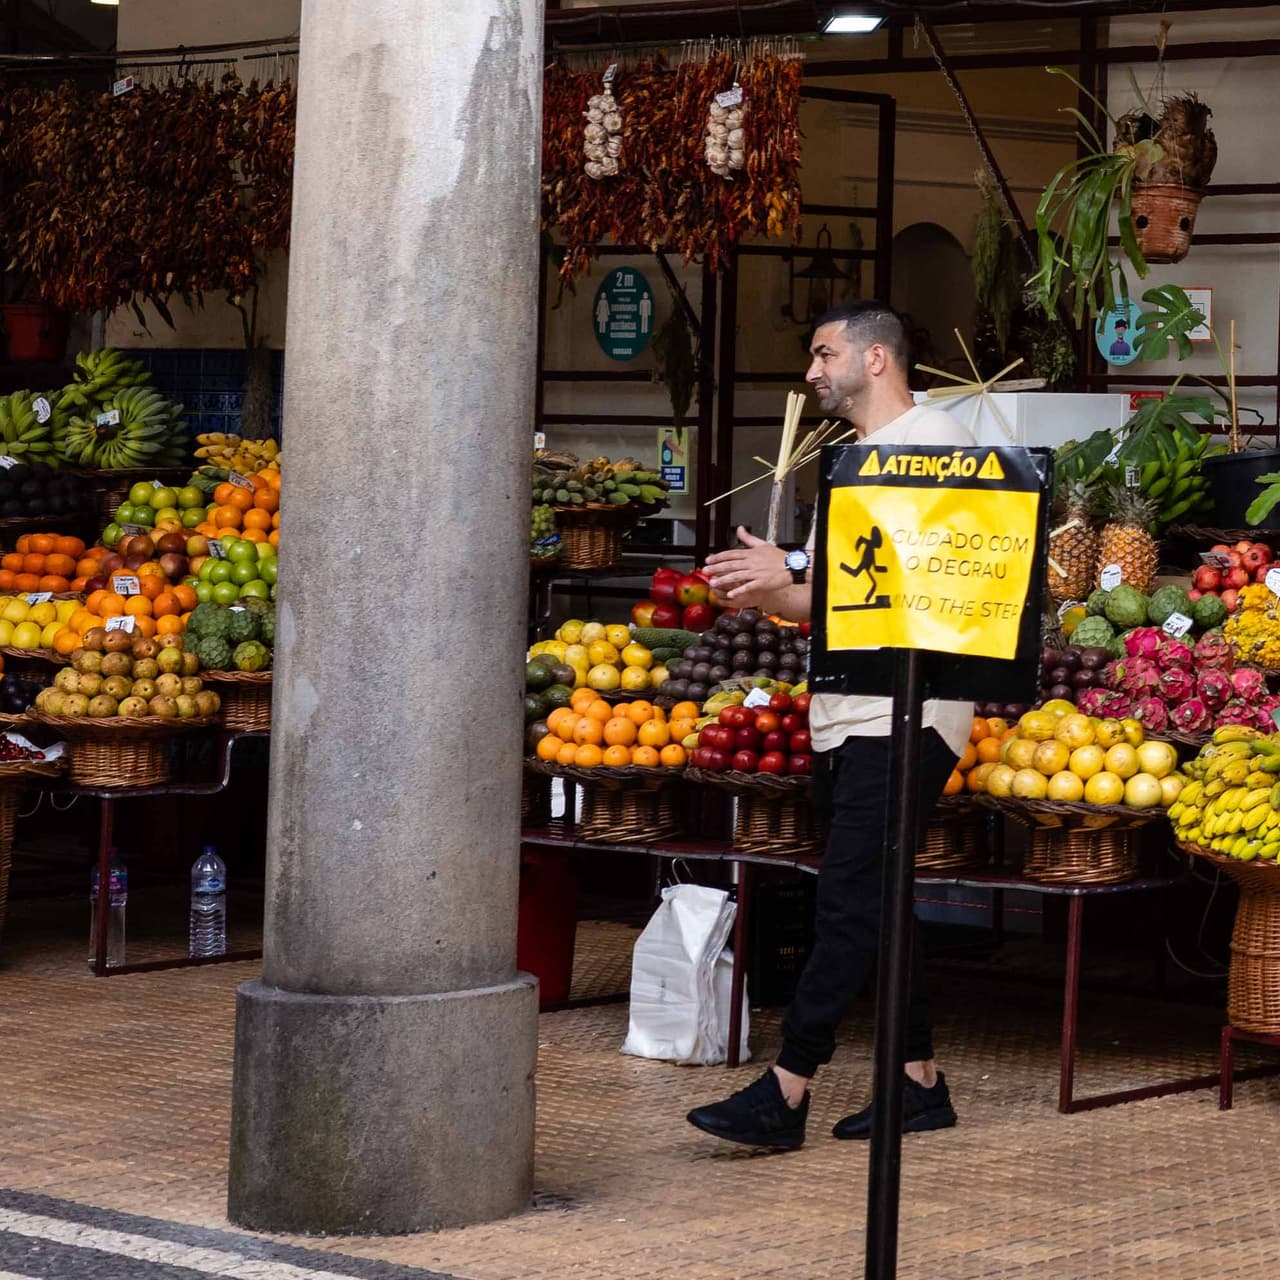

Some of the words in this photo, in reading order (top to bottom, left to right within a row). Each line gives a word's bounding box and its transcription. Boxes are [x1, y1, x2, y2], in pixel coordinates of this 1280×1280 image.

[615, 271, 624, 287] 2
[624, 274, 634, 287] m
[881, 451, 977, 482] ATENÇÃO
[892, 529, 984, 550] CUIDADO
[988, 535, 1029, 555] COM
[906, 555, 920, 571] O
[927, 557, 1007, 579] DEGRAU
[939, 598, 977, 617] THE
